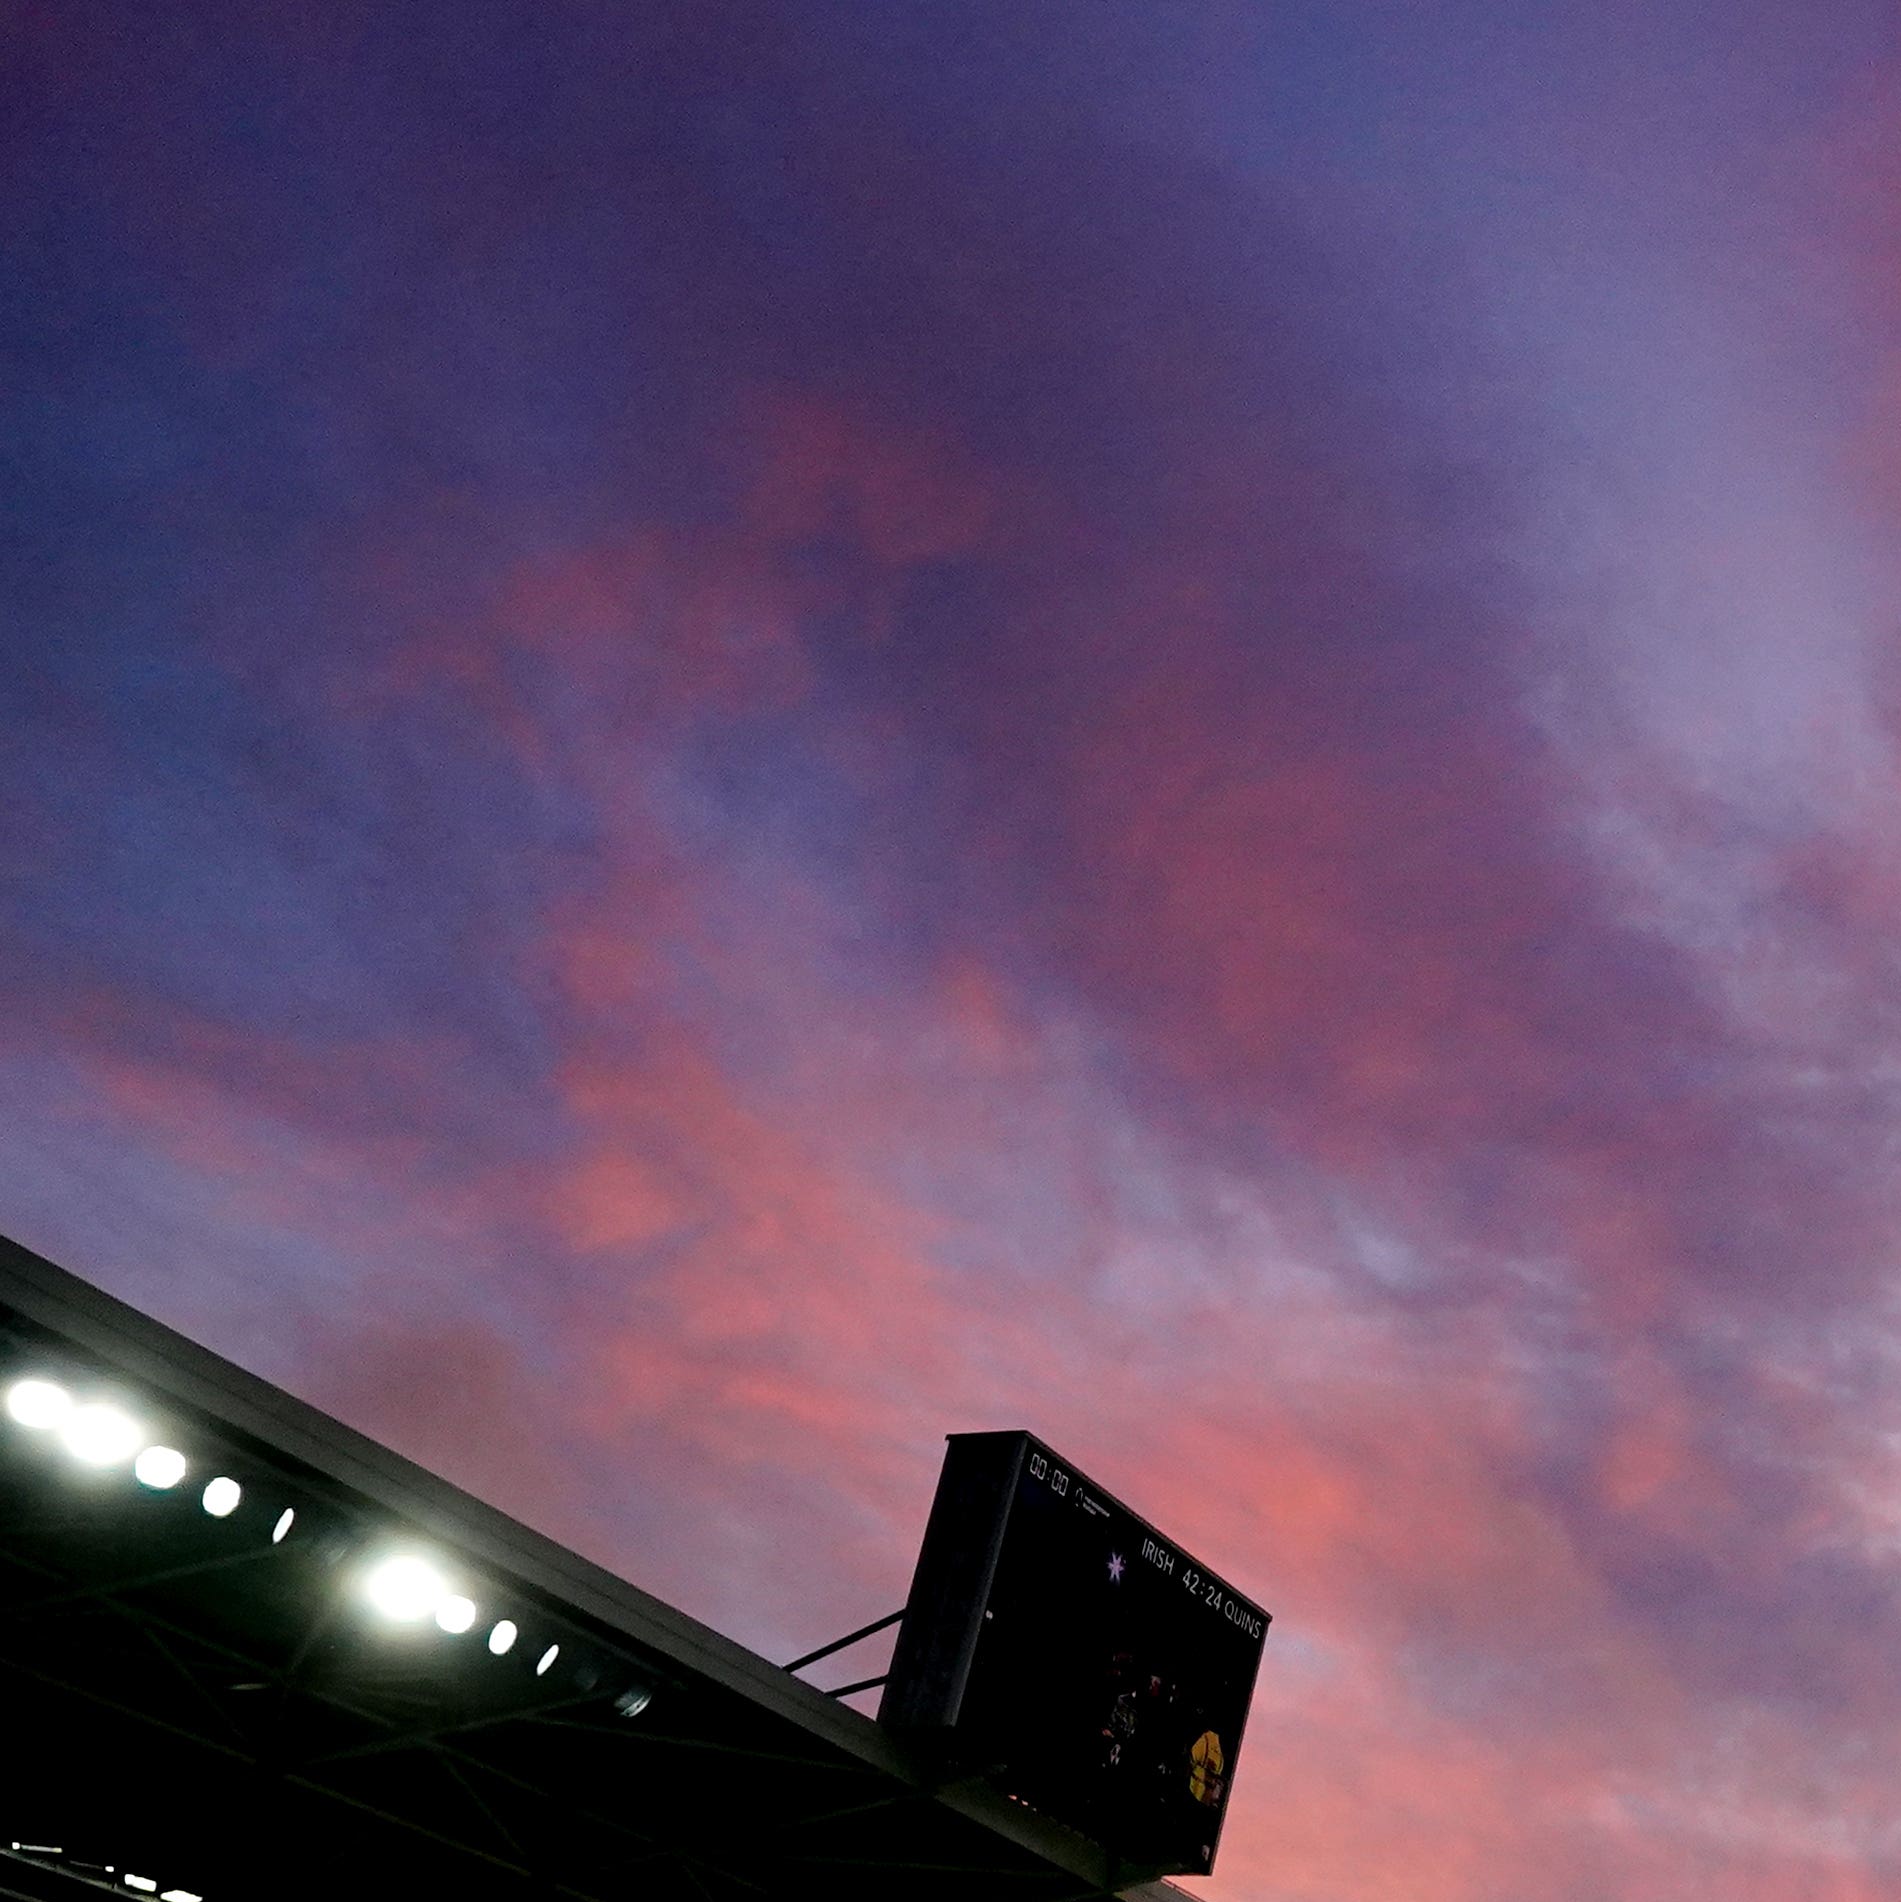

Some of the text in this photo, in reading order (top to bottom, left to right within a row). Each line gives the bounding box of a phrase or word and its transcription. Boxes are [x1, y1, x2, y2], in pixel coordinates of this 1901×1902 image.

[1141, 1538, 1262, 1639] IRISH 42:24 QUINS
